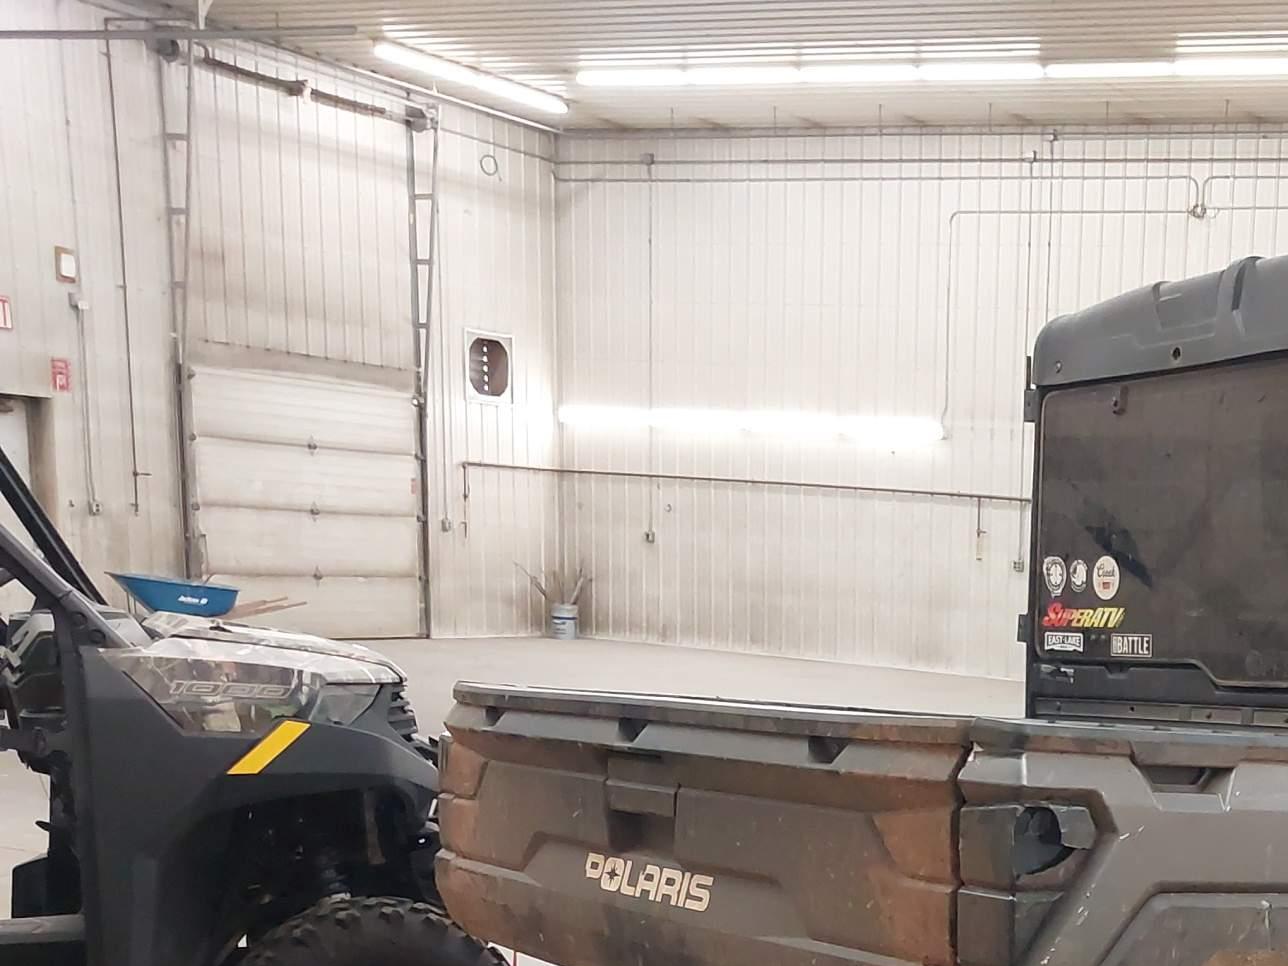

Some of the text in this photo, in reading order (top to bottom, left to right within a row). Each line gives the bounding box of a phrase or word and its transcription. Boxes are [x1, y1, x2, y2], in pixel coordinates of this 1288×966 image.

[1117, 636, 1150, 655] BATTLE
[169, 680, 291, 700] 1000
[585, 852, 714, 912] POLARIS
